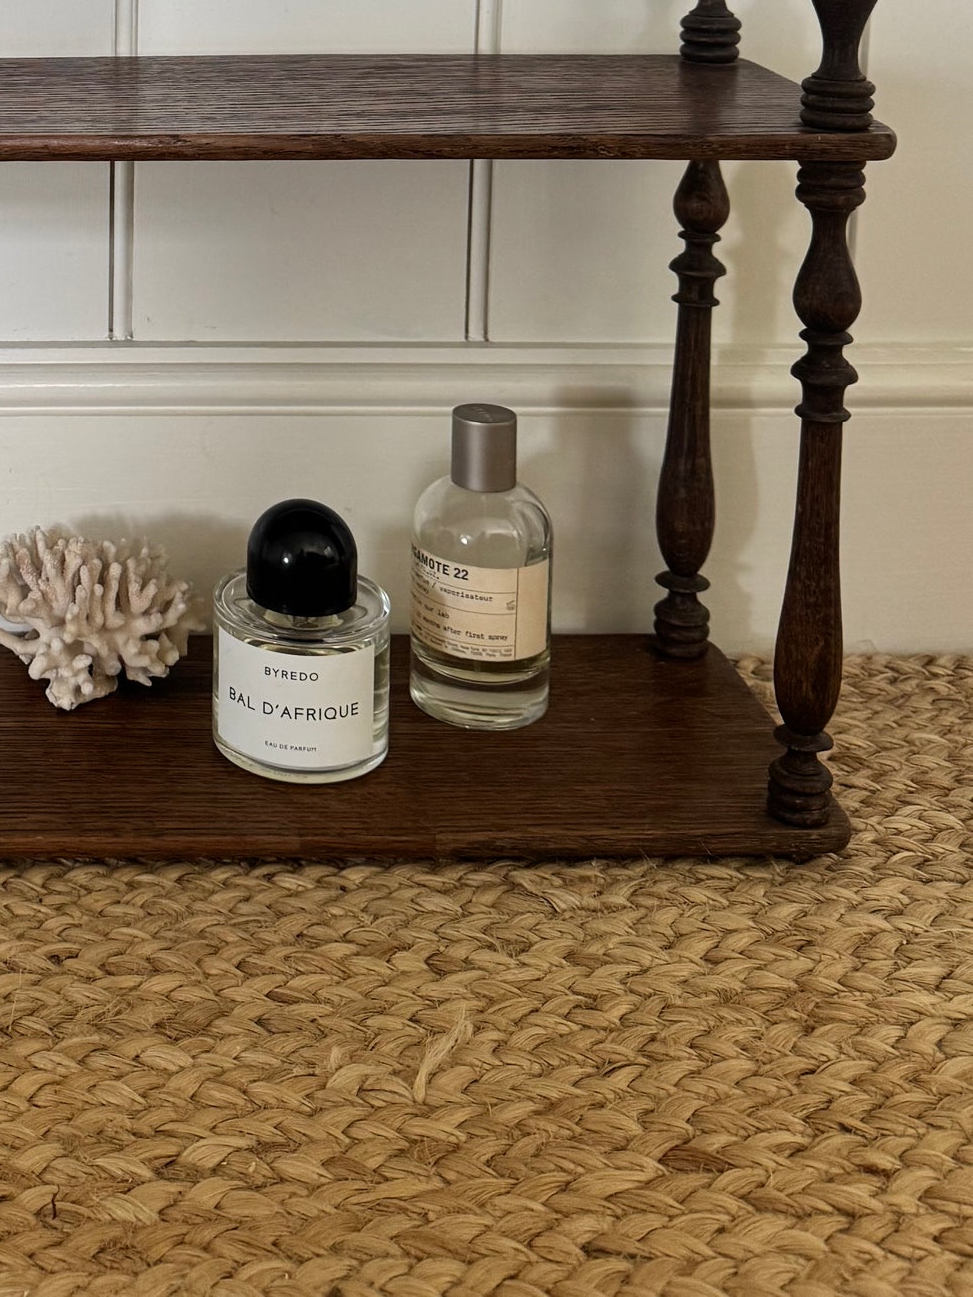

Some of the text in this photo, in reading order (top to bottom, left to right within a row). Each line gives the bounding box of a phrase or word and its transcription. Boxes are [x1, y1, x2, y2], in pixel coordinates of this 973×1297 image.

[453, 567, 469, 581] 22
[440, 586, 494, 602] vaporisateur
[465, 630, 484, 640] first
[264, 666, 319, 682] BYREDO
[229, 686, 359, 721] BAL D'AFRIQUE
[264, 740, 278, 748] EAU
[290, 744, 317, 752] PARFUM
